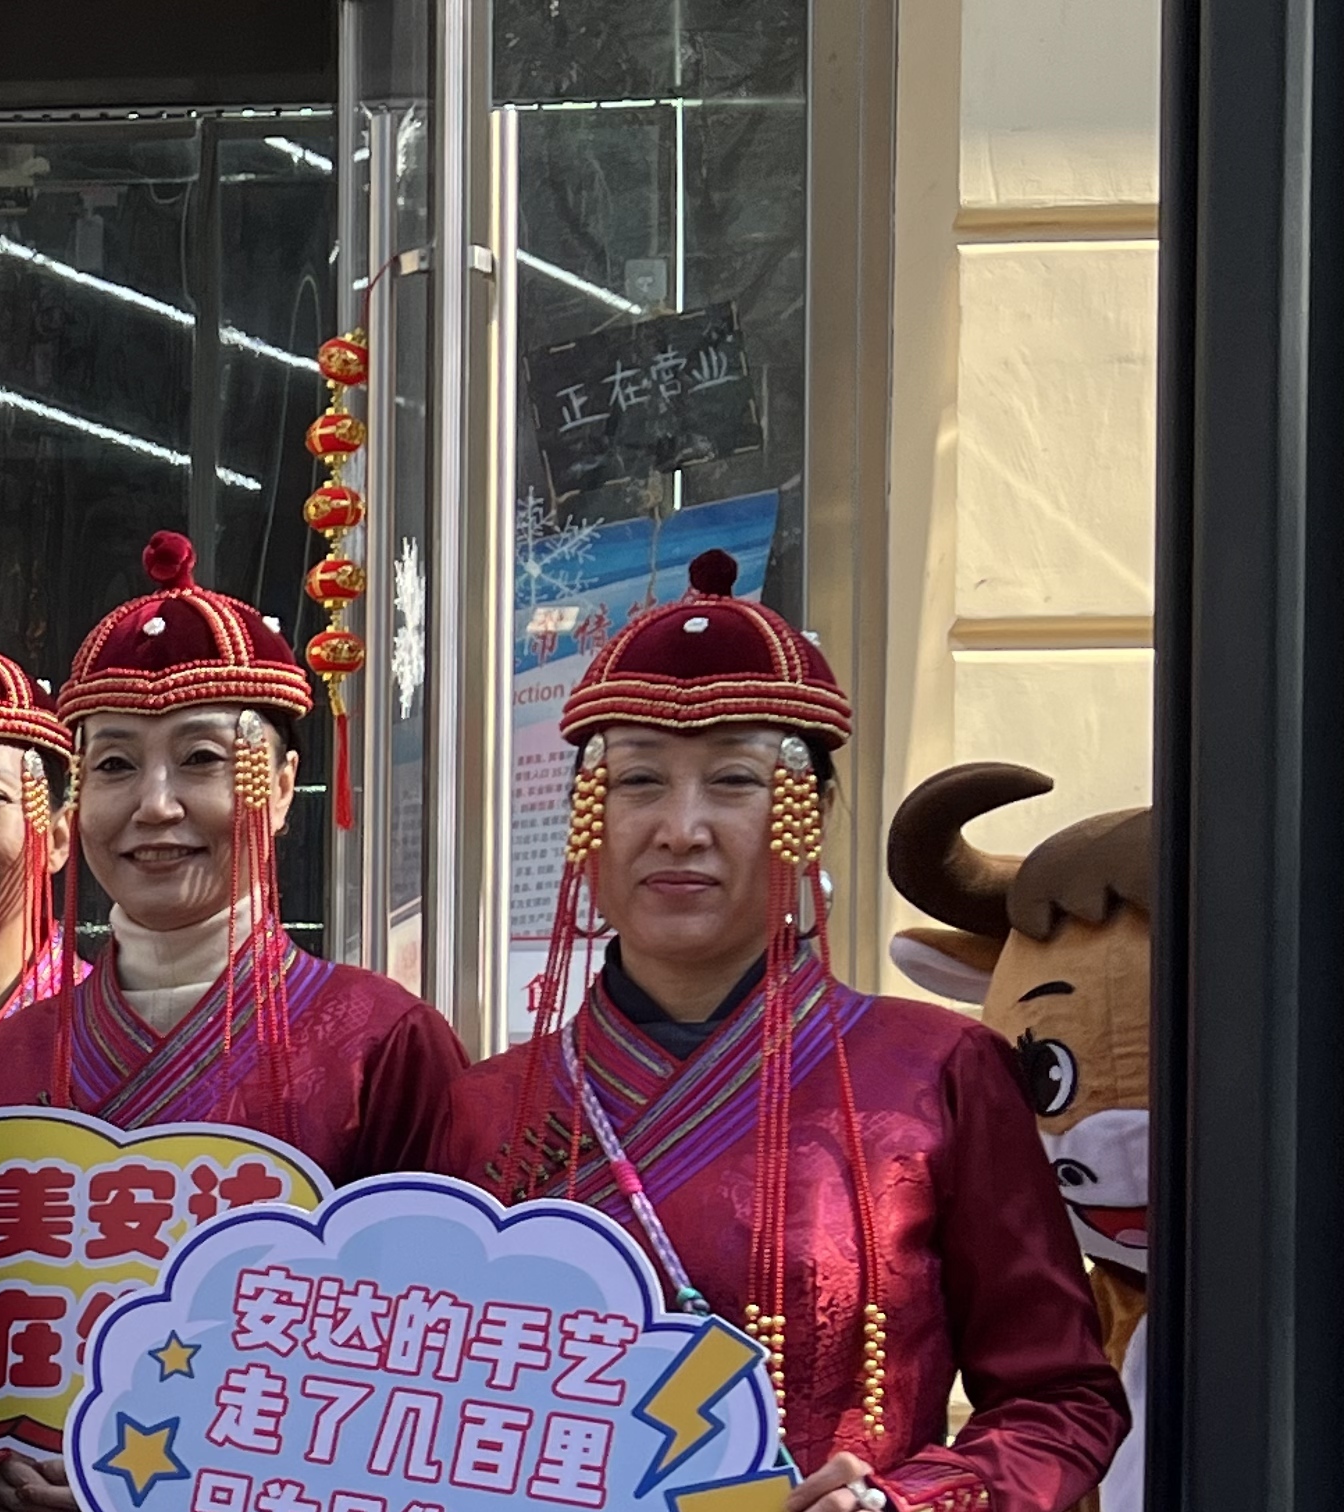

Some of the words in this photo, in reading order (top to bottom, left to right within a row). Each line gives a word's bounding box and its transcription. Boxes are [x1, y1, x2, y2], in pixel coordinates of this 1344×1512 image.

[555, 344, 740, 432] 正在营业
[231, 1265, 641, 1406] 安达的手艺
[205, 1363, 614, 1509] 走了几百里
